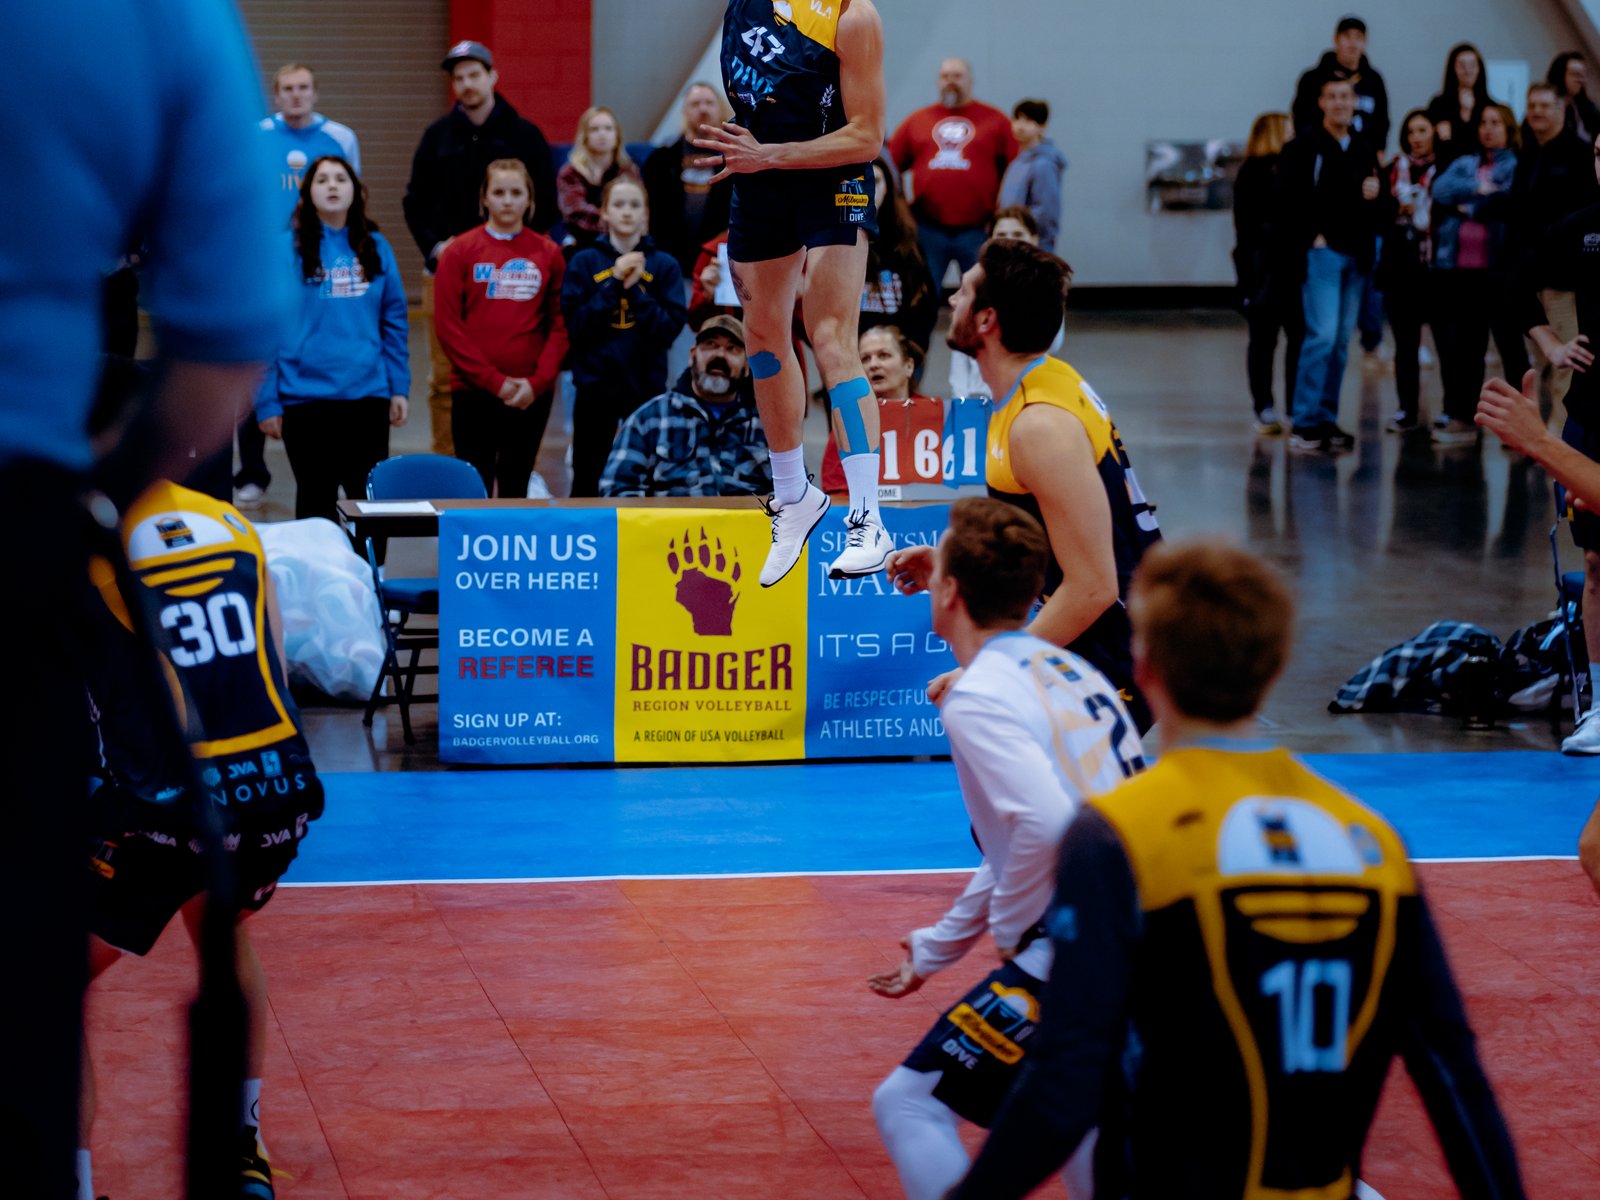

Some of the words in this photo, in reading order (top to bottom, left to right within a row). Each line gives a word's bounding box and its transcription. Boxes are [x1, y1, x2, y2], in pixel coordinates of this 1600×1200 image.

[741, 26, 786, 63] 47
[878, 488, 898, 498] OME
[457, 534, 537, 561] JOIN
[550, 534, 597, 561] US
[455, 571, 520, 590] OVER
[528, 572, 599, 590] HERE!
[160, 592, 257, 668] 30
[459, 628, 569, 648] BECOME
[576, 628, 594, 646] A
[819, 633, 880, 658] IT'S
[891, 632, 915, 657] A
[925, 631, 953, 653] G
[459, 656, 594, 680] REFEREE
[630, 643, 793, 691] BADGER
[633, 701, 689, 712] REGION
[696, 700, 792, 712] VOLLEYBALL
[823, 693, 840, 709] BE
[453, 713, 499, 729] SIGN
[504, 712, 529, 728] UP
[533, 712, 562, 727] AT:
[820, 718, 904, 739] ATHLETES
[908, 717, 945, 737] AND
[633, 731, 641, 742] A
[644, 730, 681, 742] REGION
[684, 730, 697, 742] OF
[701, 730, 721, 742] USA
[724, 729, 785, 742] VOLLEYBALL
[209, 773, 307, 806] NOVUS
[260, 828, 292, 848] JVA
[1259, 958, 1353, 1074] 10
